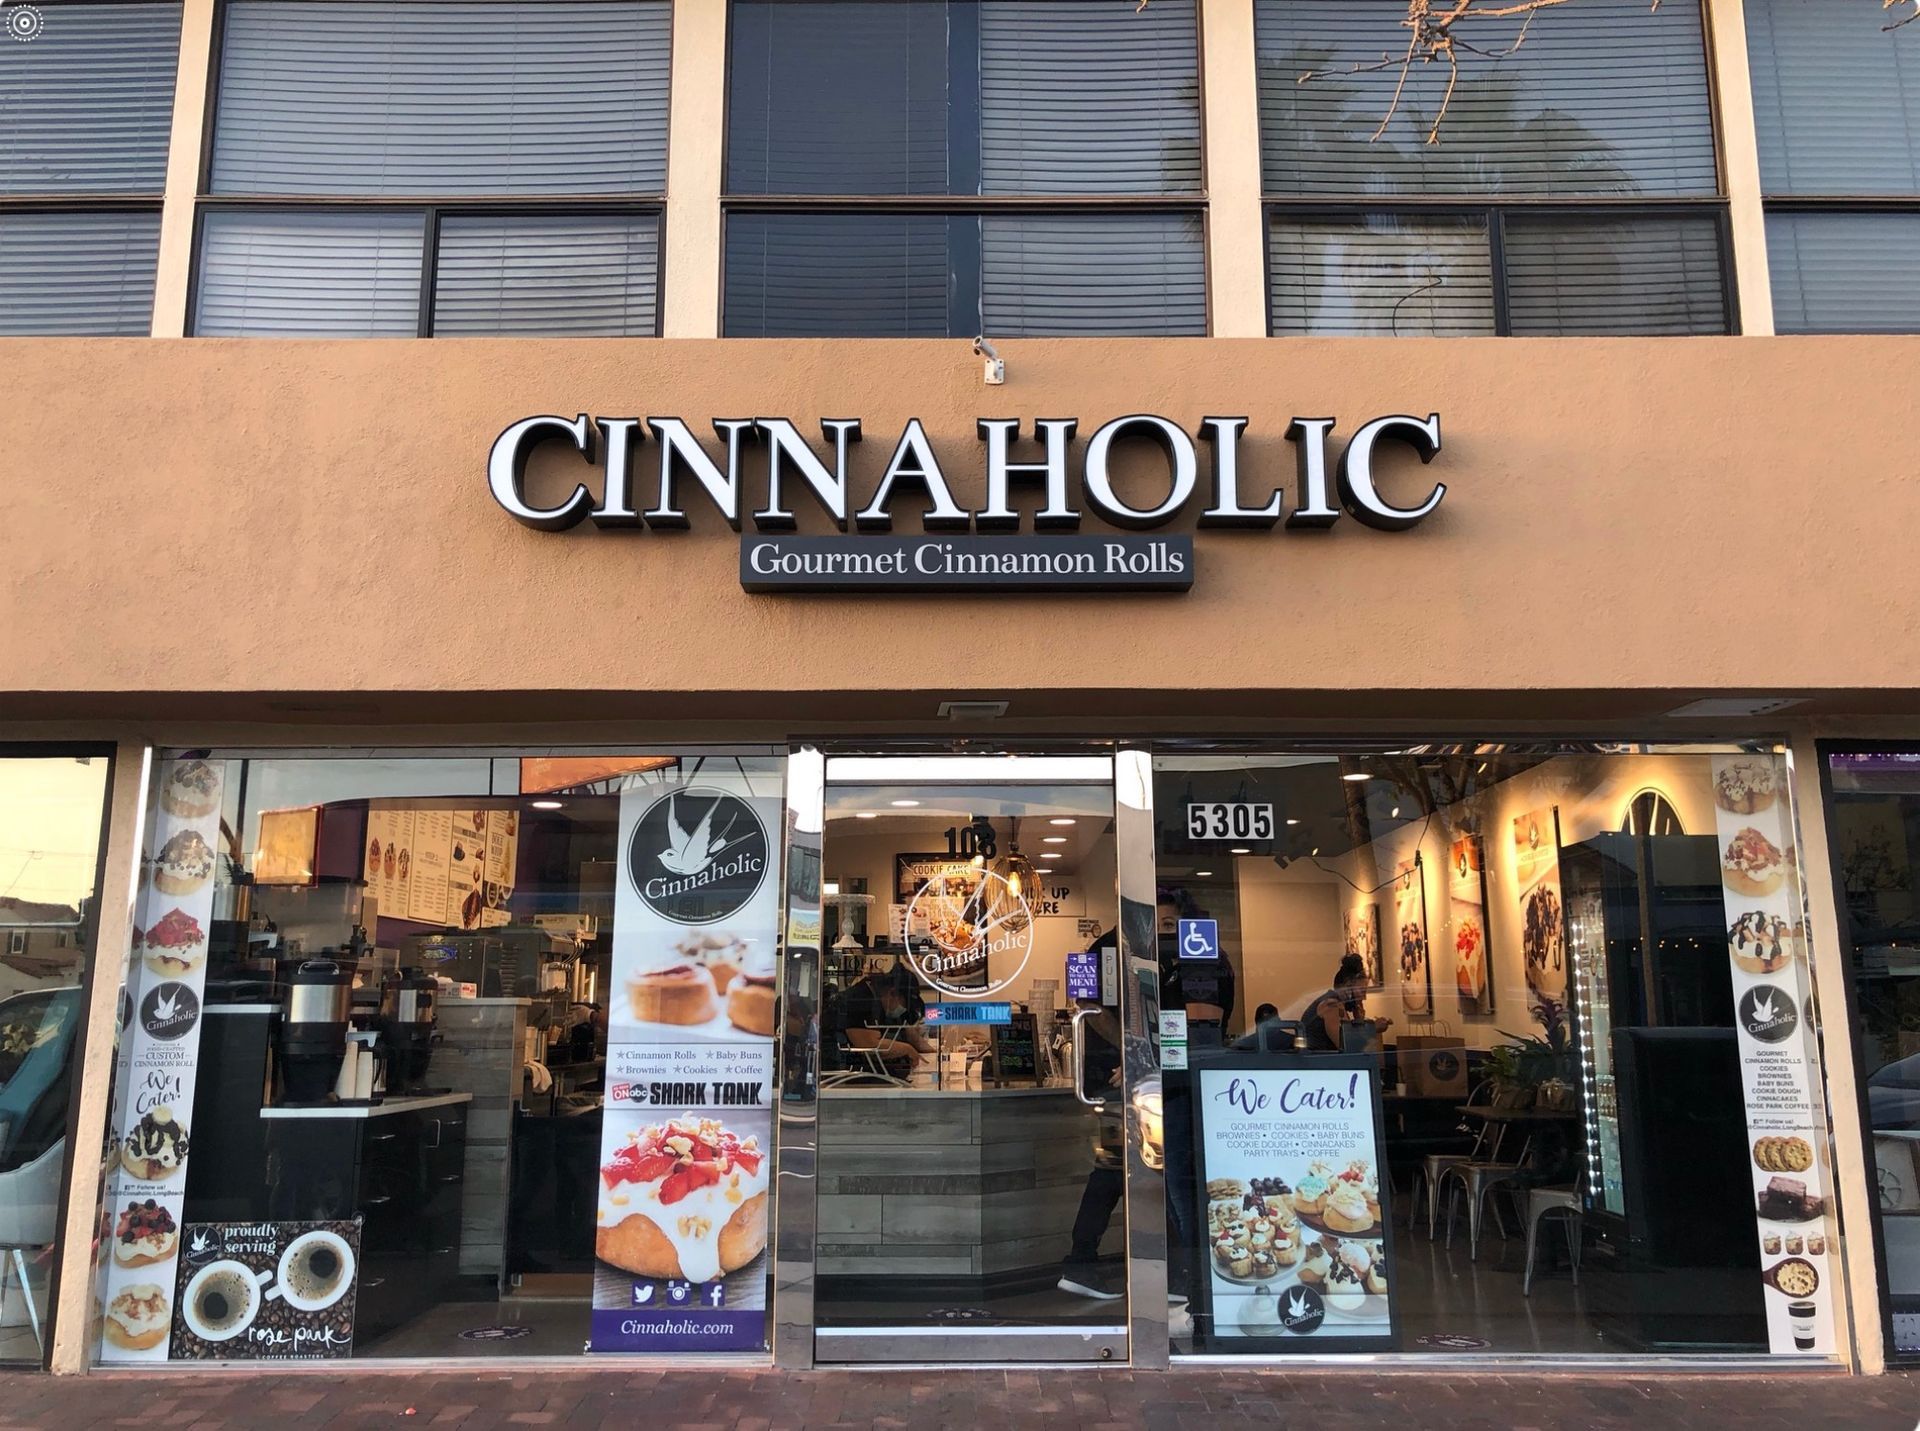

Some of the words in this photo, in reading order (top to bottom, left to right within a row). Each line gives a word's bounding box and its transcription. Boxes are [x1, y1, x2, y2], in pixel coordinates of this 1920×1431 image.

[487, 413, 1447, 528] CINNAHOLIC
[750, 543, 908, 574] Gourmet
[914, 543, 1097, 574] Cinnamon
[1104, 542, 1185, 574] Rolls
[1190, 803, 1272, 838] 5305
[645, 853, 762, 900] Cinnaholic
[1051, 887, 1070, 900] UP
[922, 930, 1027, 974] Cinnaholic
[1068, 965, 1097, 974] SCAN
[1068, 978, 1097, 987] MENU
[146, 1009, 198, 1032] Cinnaholic
[944, 1006, 978, 1021] SHARK
[981, 1006, 1010, 1021] TANK
[1747, 1014, 1797, 1034] Cinnaholic
[145, 1051, 185, 1060] CUSTOM
[625, 1050, 672, 1060] Cinnamon
[674, 1050, 697, 1060] Rolls
[716, 1051, 737, 1061] Baby
[740, 1051, 763, 1060] Buns
[625, 1065, 667, 1074] Brownies
[683, 1065, 718, 1074] Cookies
[734, 1065, 763, 1074] Coffee
[139, 1069, 174, 1090] We
[136, 1076, 181, 1114] Cater!
[614, 1089, 630, 1099] ON
[630, 1087, 648, 1097] abc
[649, 1082, 707, 1105] SHARK
[712, 1082, 763, 1105] TANK
[1215, 1078, 1271, 1115] We
[1280, 1073, 1359, 1114] Cater!
[1216, 1131, 1261, 1140] BROWNIES
[1270, 1131, 1309, 1140] COOKIES
[1317, 1131, 1340, 1140] BABY
[1341, 1131, 1365, 1140] BUNS
[1230, 1122, 1273, 1131] GOURMET
[1274, 1122, 1321, 1131] CINNAMON
[1322, 1122, 1350, 1131] ROLLS
[1226, 1140, 1260, 1149] COOKIE
[1261, 1140, 1293, 1149] DOUGH
[1301, 1140, 1356, 1149] CINNACAKES
[1243, 1149, 1270, 1158] PARTY
[1271, 1149, 1299, 1158] TRAYS
[1306, 1149, 1340, 1158] COFFEE
[223, 1223, 279, 1240] proudly
[223, 1240, 277, 1256] serving
[1284, 1308, 1323, 1327] Cinnaholic
[620, 1318, 734, 1336] Cinnaholic.com
[248, 1326, 293, 1346] rose
[293, 1325, 351, 1352] park
